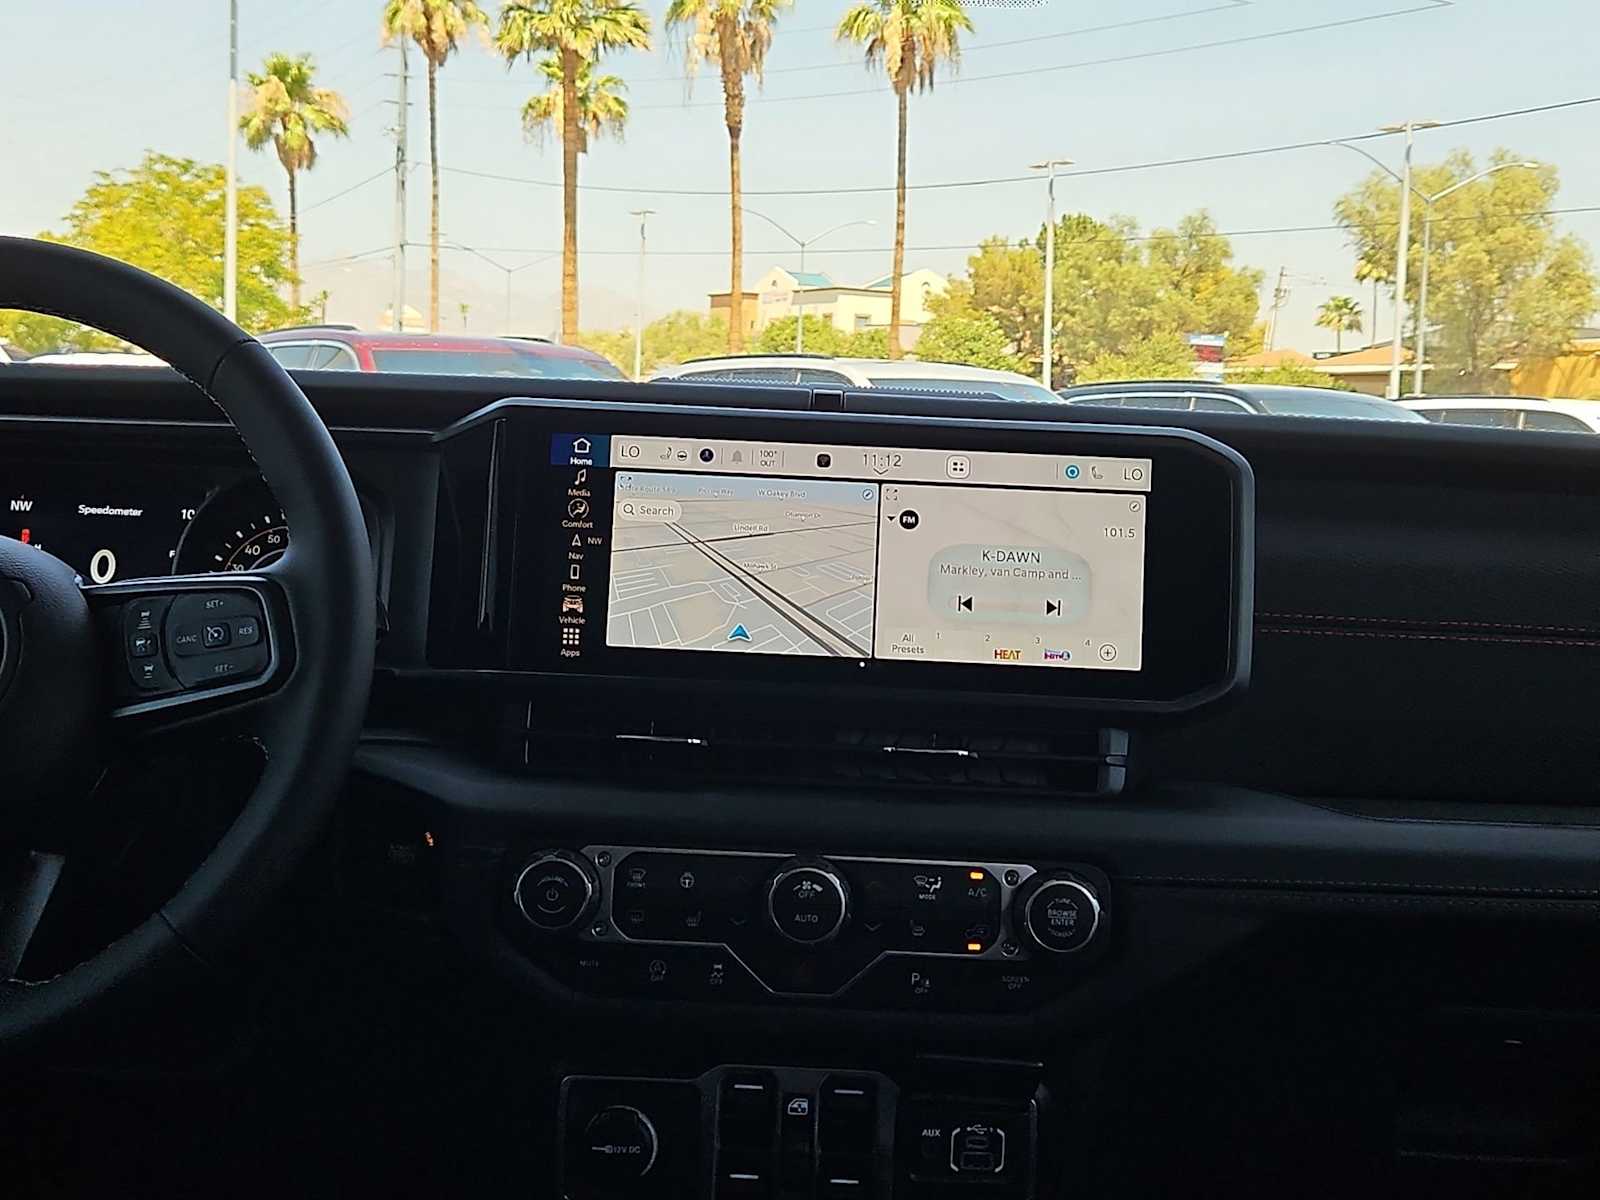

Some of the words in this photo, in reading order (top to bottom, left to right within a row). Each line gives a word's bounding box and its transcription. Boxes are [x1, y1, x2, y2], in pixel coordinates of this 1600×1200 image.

[621, 445, 640, 458] LO
[570, 457, 593, 466] Home
[862, 453, 903, 468] 11:12
[1123, 467, 1143, 481] LO
[567, 489, 591, 497] Media
[10, 500, 33, 511] NW
[78, 504, 144, 516] Speedometer
[639, 505, 674, 516] Search
[561, 520, 594, 529] Comfort
[902, 516, 916, 524] FM
[1103, 527, 1136, 538] 101.5
[267, 534, 281, 544] 50
[587, 537, 603, 545] NW
[245, 544, 261, 556] 40
[568, 552, 584, 560] Nav
[981, 549, 1041, 564] K-DAWN
[90, 548, 116, 585] 0
[940, 564, 987, 578] Markley,
[990, 567, 1011, 577] van
[1013, 567, 1045, 580] Camp
[1048, 569, 1069, 580] and
[562, 584, 586, 592] Phone
[559, 616, 586, 625] Vehicle
[902, 633, 914, 643] All
[984, 634, 991, 642] 2
[1034, 637, 1041, 645] 3
[560, 649, 581, 657] Apps
[891, 644, 925, 655] Presets
[968, 887, 988, 898] A/C
[793, 912, 819, 924] AUTO
[922, 1128, 941, 1137] AUX
